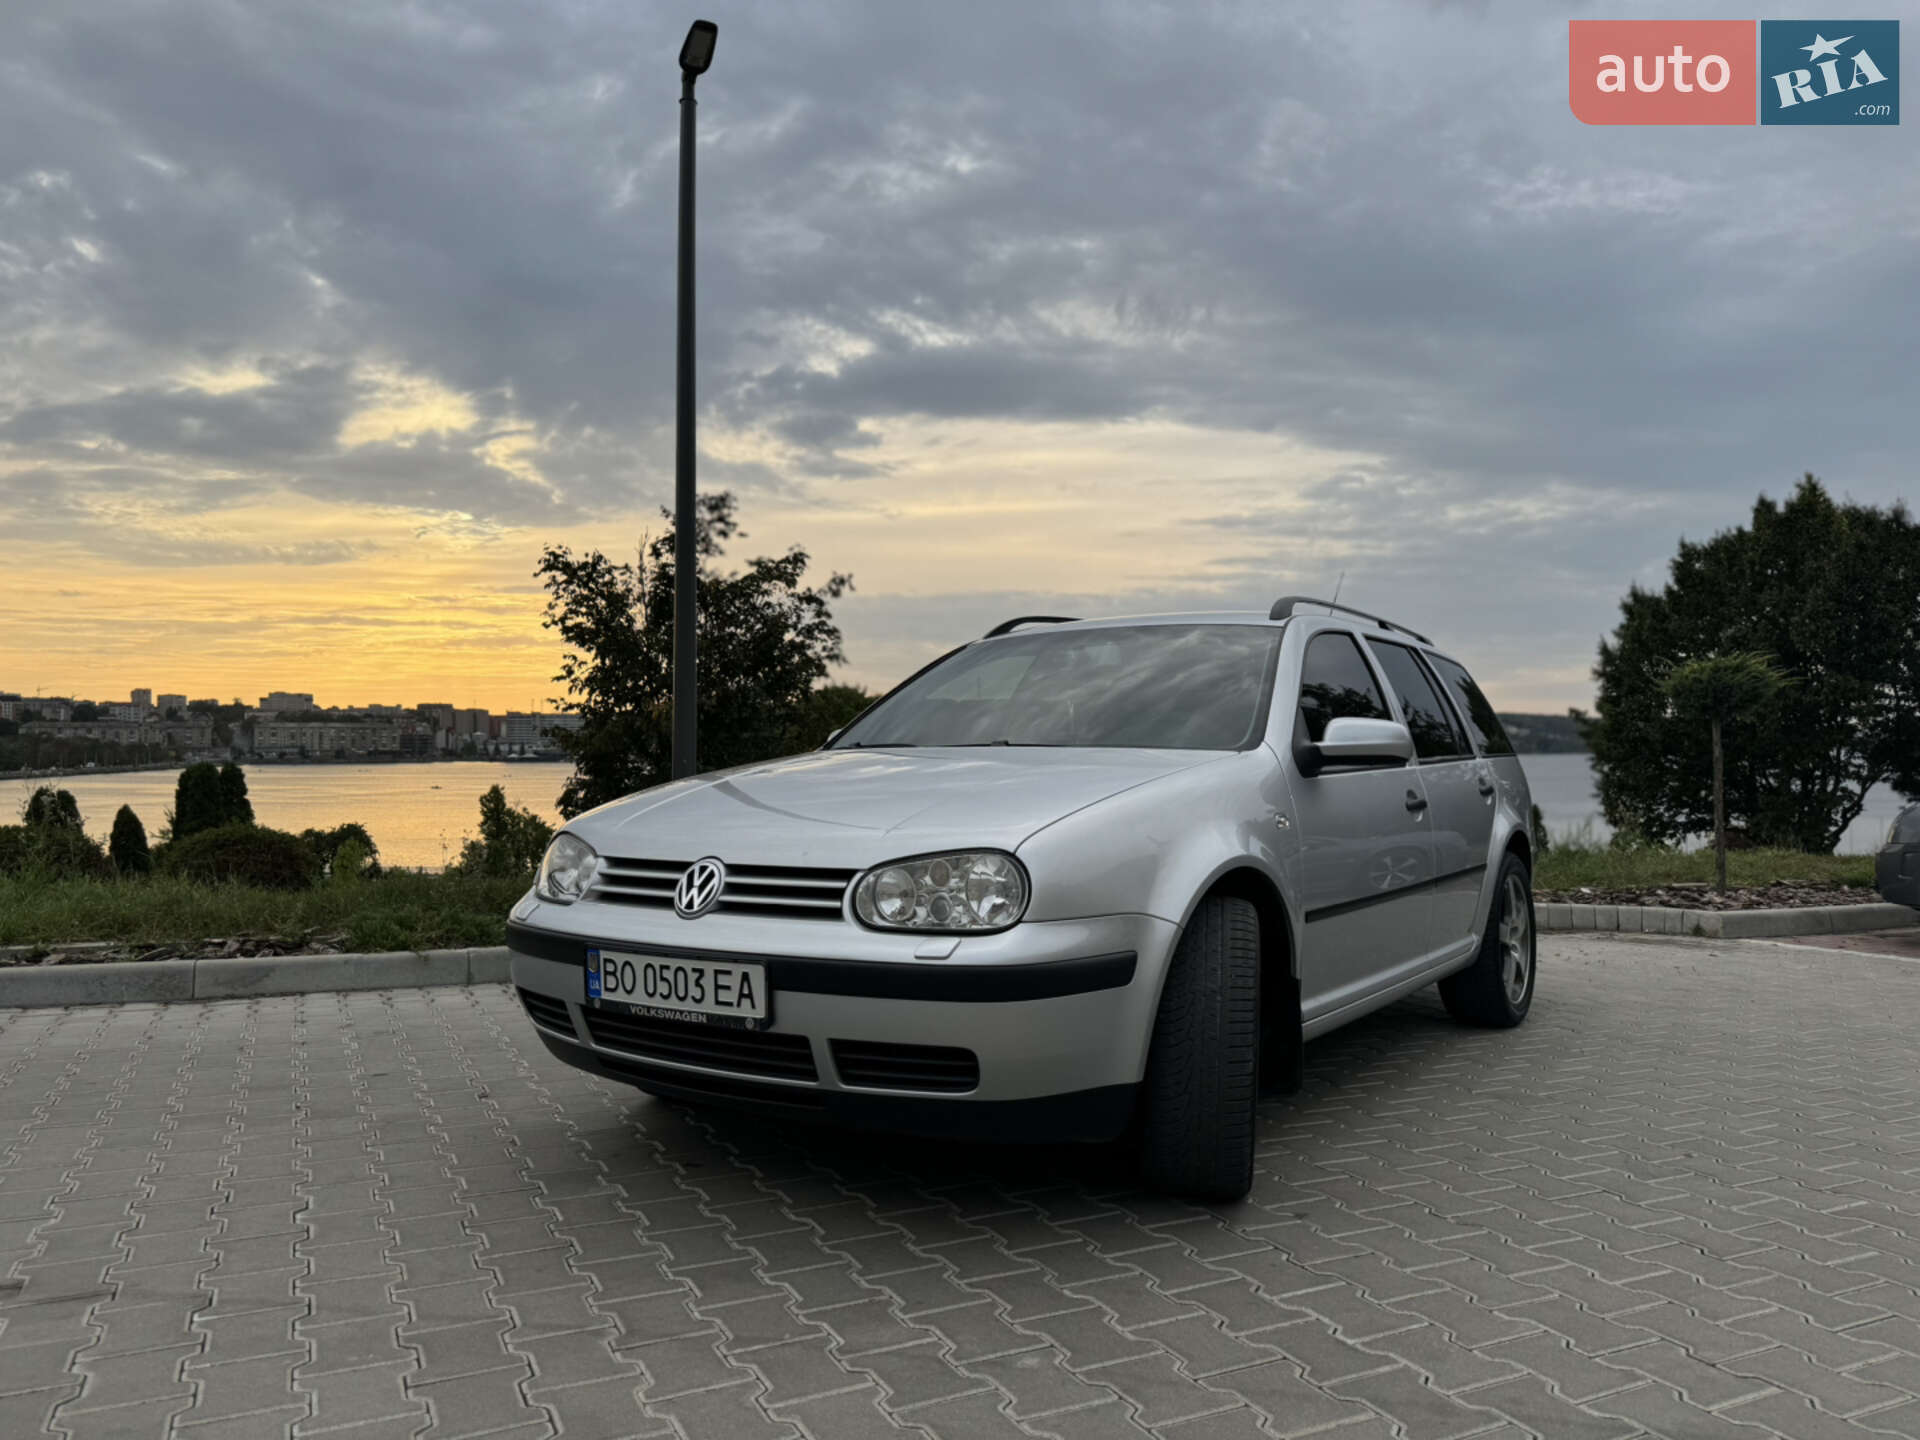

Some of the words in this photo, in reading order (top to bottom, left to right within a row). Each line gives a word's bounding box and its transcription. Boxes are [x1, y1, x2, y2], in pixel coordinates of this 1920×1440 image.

[589, 979, 600, 990] UA
[603, 957, 637, 995] BO
[643, 962, 705, 1004] 0503
[713, 969, 756, 1010] EA
[629, 1005, 707, 1024] VOLKSWAGEN
